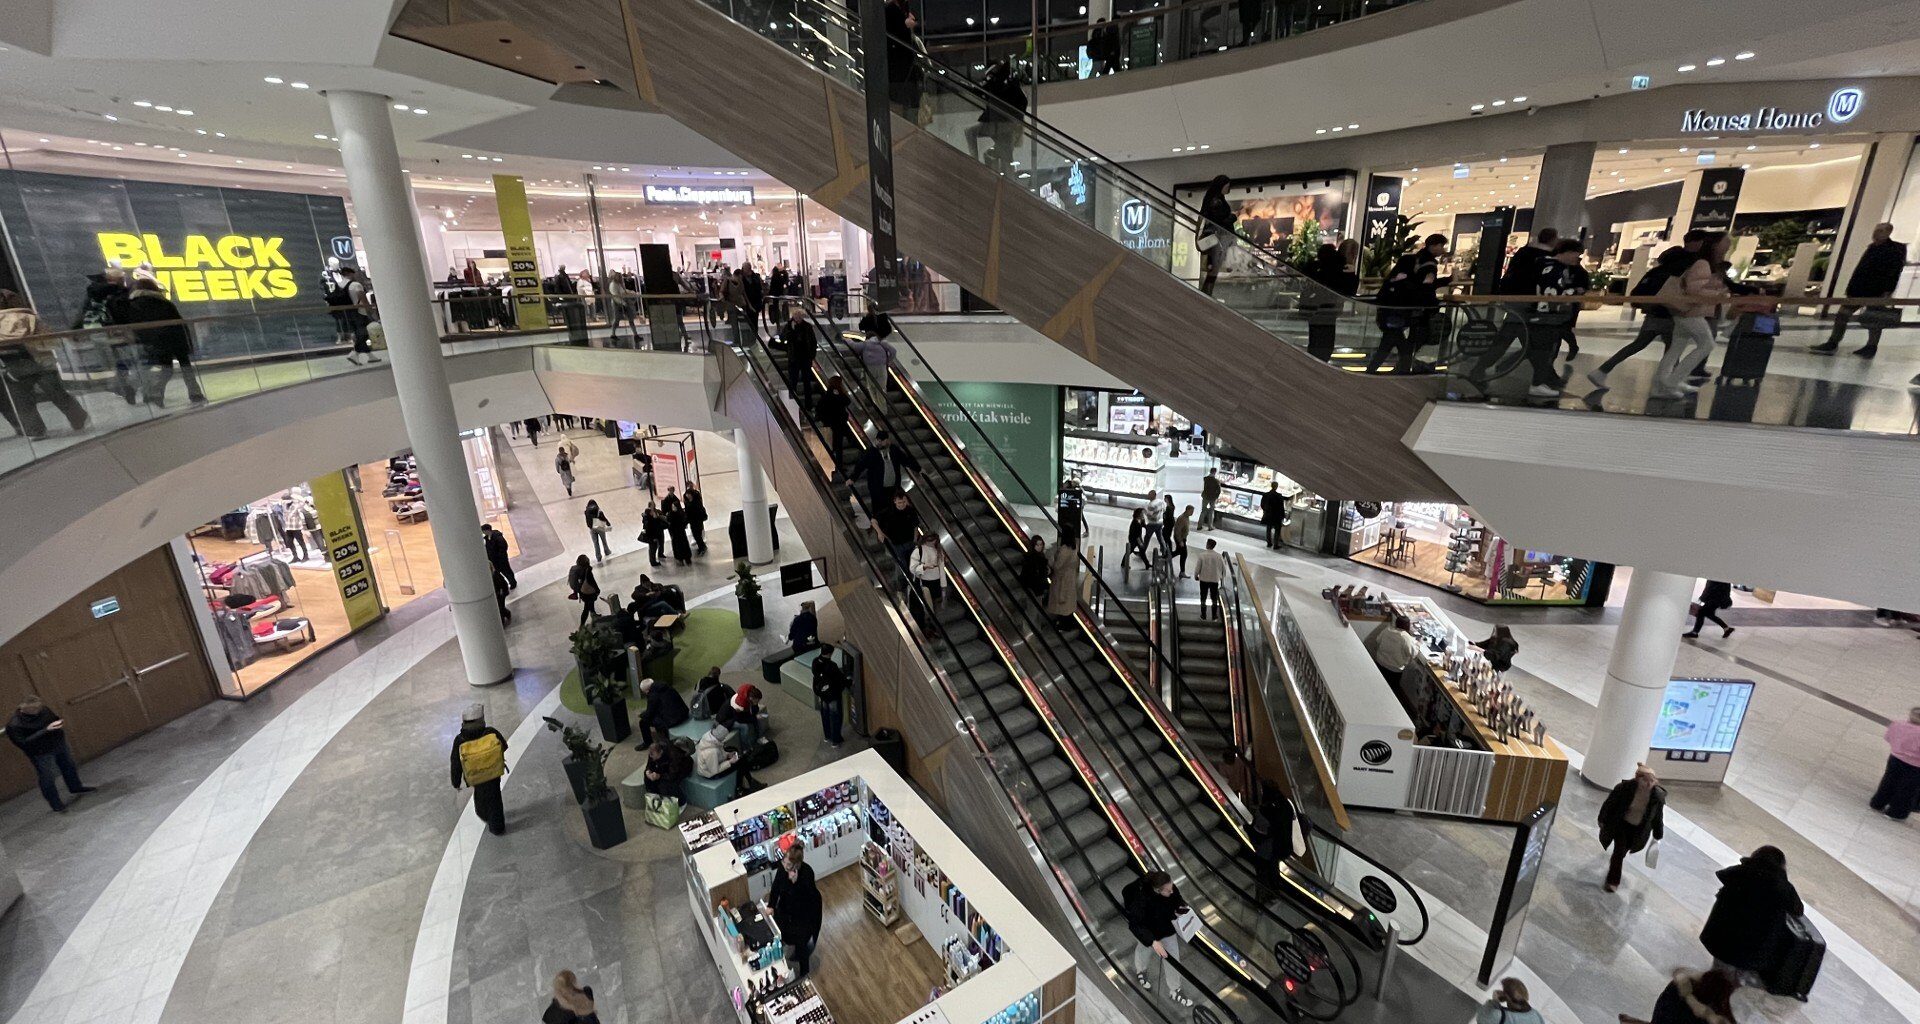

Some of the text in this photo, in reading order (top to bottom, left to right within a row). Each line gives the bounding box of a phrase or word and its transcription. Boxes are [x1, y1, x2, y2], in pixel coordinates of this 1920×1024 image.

[1681, 107, 1823, 132] Mensa Home
[97, 233, 291, 268] BLACK
[979, 410, 999, 424] tak
[1000, 411, 1032, 425] wiele
[329, 526, 351, 537] BLACK
[335, 544, 357, 559] 20%
[340, 563, 361, 578] 25%
[345, 580, 367, 596] 30%
